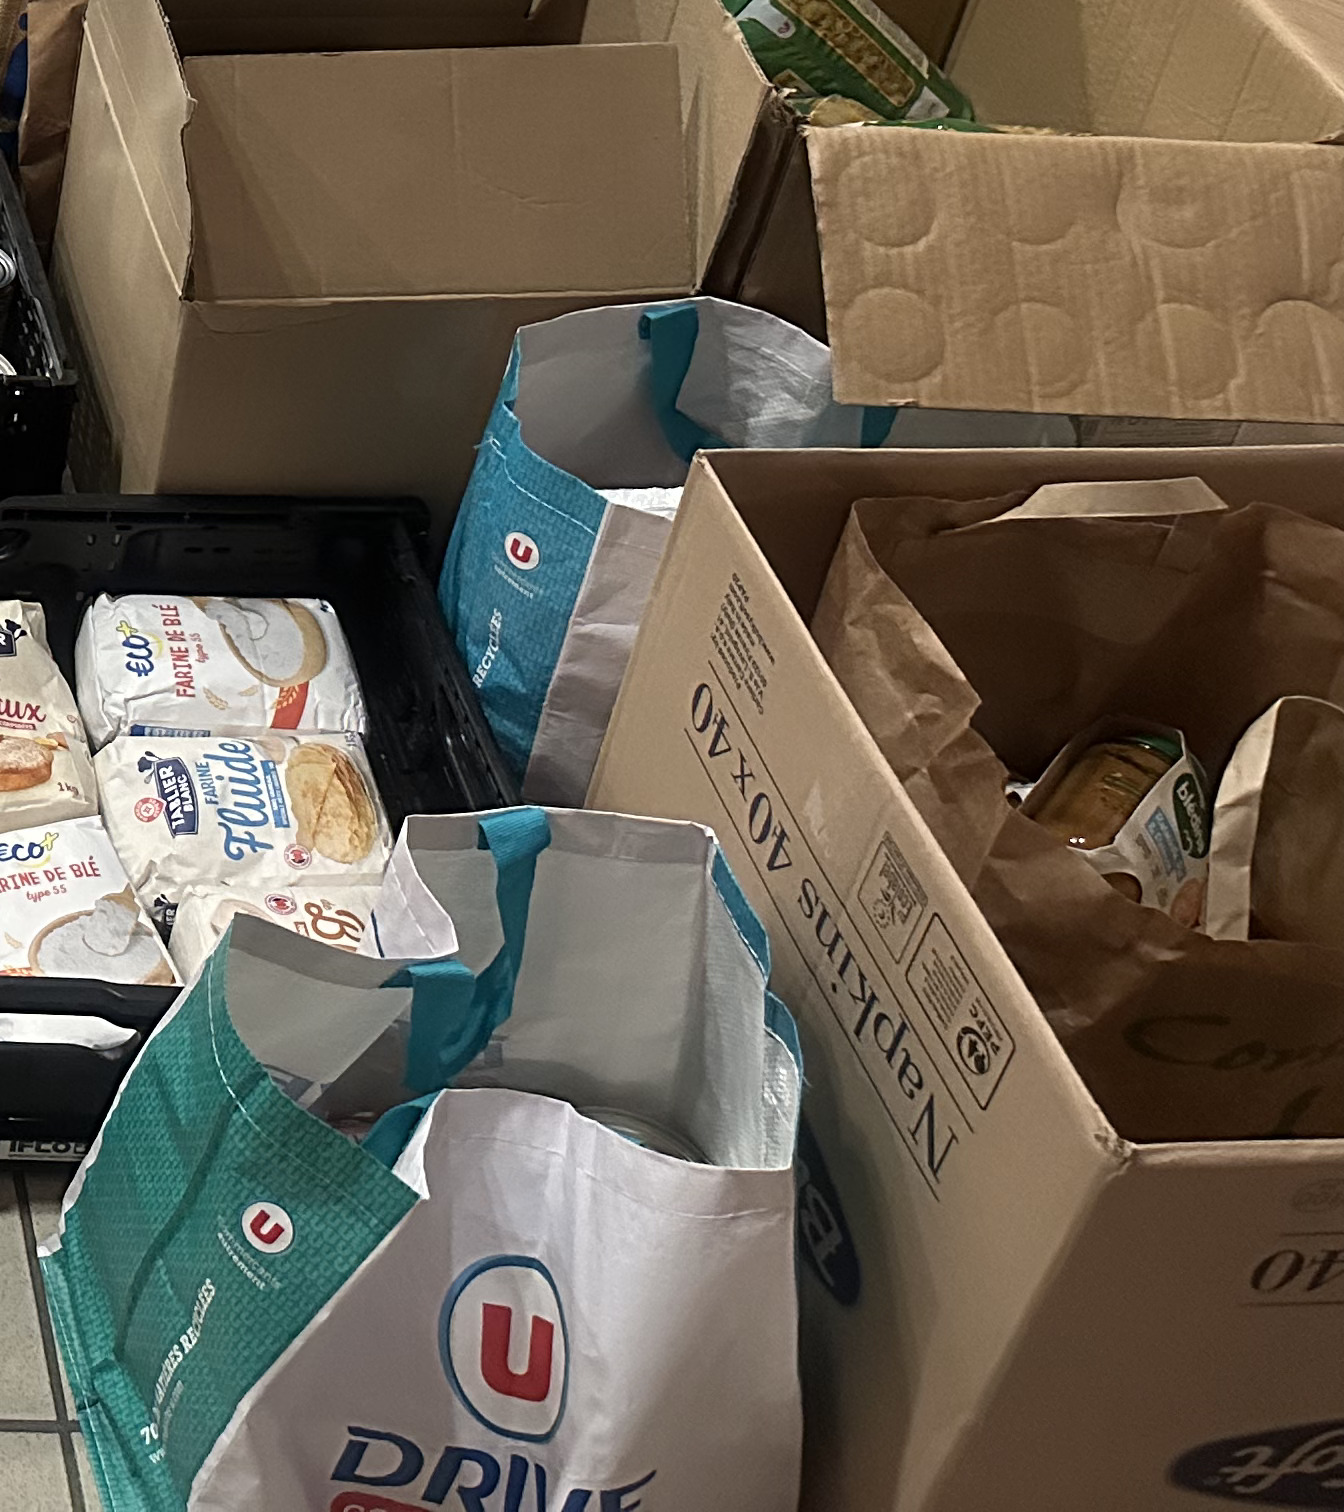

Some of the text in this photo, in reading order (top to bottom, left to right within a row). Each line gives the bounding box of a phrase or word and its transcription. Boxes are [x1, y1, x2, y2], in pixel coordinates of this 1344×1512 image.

[509, 538, 533, 563] U
[152, 603, 196, 698] FARINE DE BLÉ
[473, 609, 503, 688] RECYCLÉES
[690, 682, 733, 759] 40
[159, 763, 185, 830] TABLIER
[178, 773, 194, 813] BLANC
[195, 761, 220, 806] FARINE
[203, 741, 274, 863] Fluide
[748, 792, 795, 871] 40
[26, 885, 68, 902] type 55
[44, 867, 68, 882] DE
[69, 855, 101, 878] BLÉ
[797, 877, 958, 1185] Napkins
[249, 1209, 285, 1244] U
[481, 1302, 555, 1403] U
